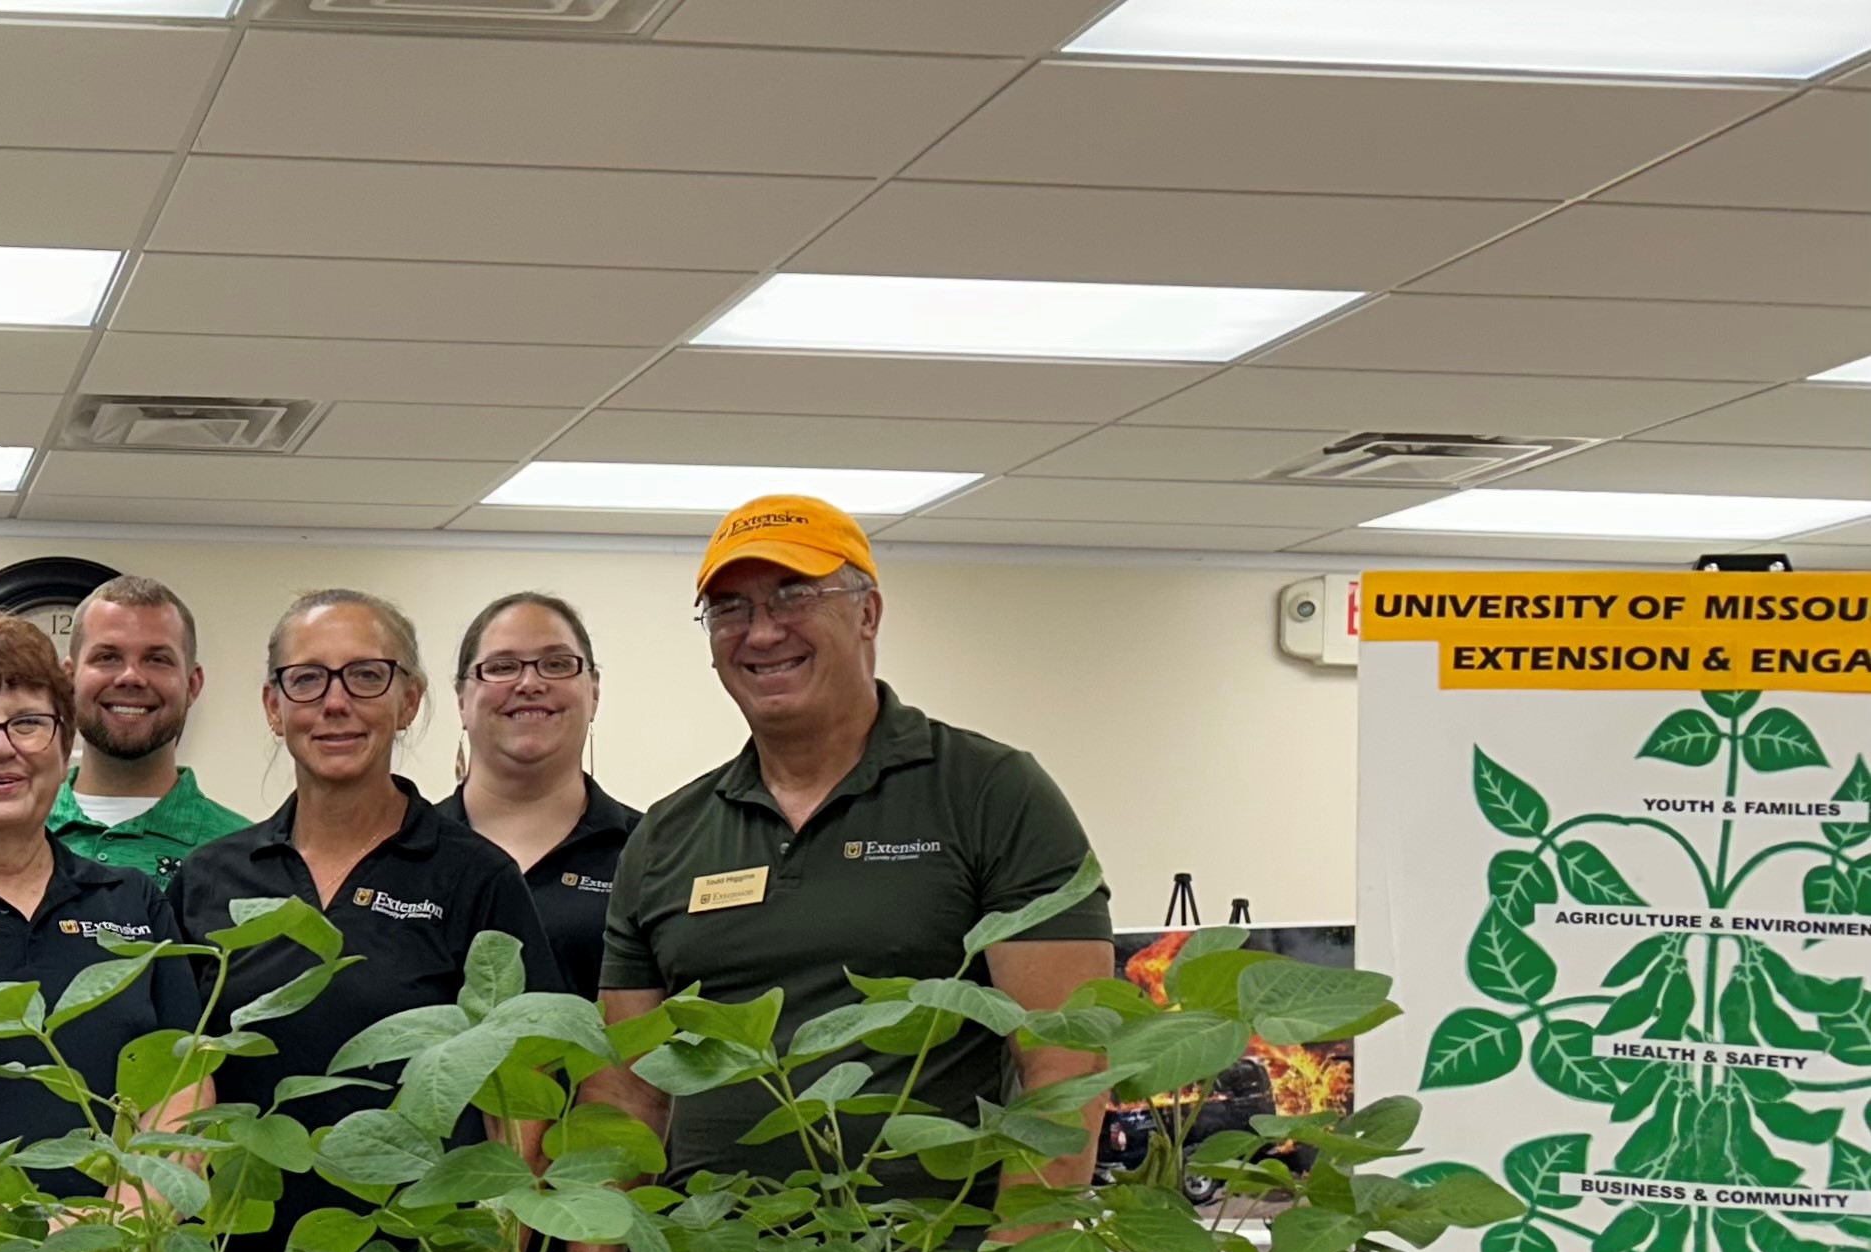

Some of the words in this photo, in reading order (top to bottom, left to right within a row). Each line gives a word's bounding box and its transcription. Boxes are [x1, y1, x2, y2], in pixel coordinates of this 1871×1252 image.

[1374, 594, 1617, 618] UNIVERSITY
[1628, 595, 1685, 619] OF
[1704, 595, 1867, 621] MISSOU
[52, 614, 73, 635] 12
[1453, 645, 1689, 670] EXTENSION
[1702, 646, 1729, 670] &
[1751, 648, 1871, 673] ENGA
[1643, 798, 1714, 812] YOUTH
[1722, 800, 1736, 813] &
[1744, 801, 1840, 816] FAMILIES
[865, 839, 941, 855] Extension
[374, 891, 443, 920] Extension
[1555, 911, 1701, 927] AGRICULTURE
[1709, 915, 1723, 931] &
[1613, 1043, 1695, 1061] HEALTH
[1703, 1050, 1717, 1062] &
[1725, 1051, 1807, 1069] SAFETY
[1580, 1179, 1686, 1201] BUSINESS
[1693, 1188, 1708, 1202] &
[1715, 1189, 1849, 1208] COMMUNITY
